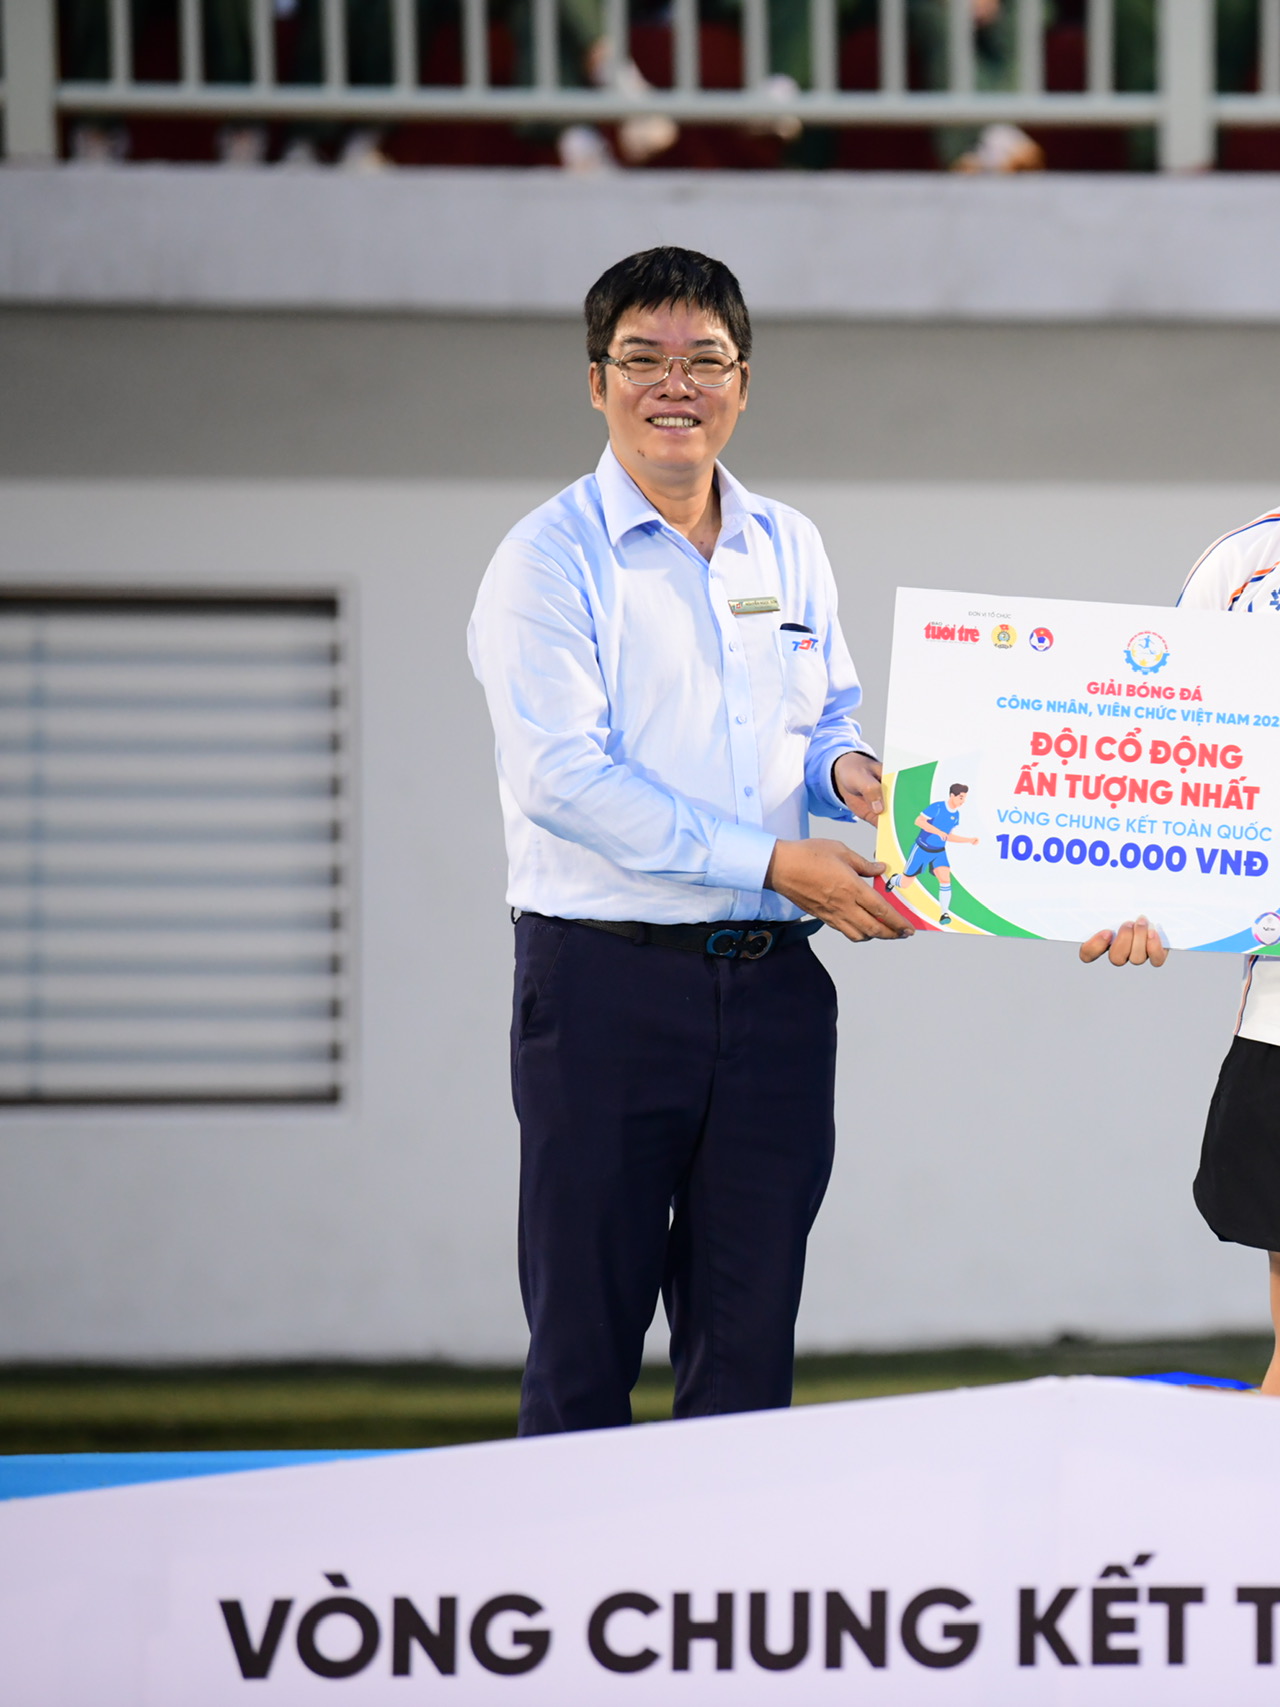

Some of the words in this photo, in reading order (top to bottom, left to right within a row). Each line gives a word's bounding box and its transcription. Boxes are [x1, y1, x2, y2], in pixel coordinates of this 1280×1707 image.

[996, 694, 1042, 711] CÔNG
[1046, 698, 1093, 718] NHÂN,
[1097, 702, 1131, 718] VIÊN
[1134, 704, 1177, 720] CHỨC
[1181, 708, 1213, 726] VIỆT
[1216, 712, 1250, 726] NAM
[1086, 680, 1122, 696] GIẢI
[1126, 682, 1176, 700] BÓNG
[1179, 685, 1203, 702] ĐÁ
[1030, 727, 1088, 766] ĐỘI
[1095, 727, 1142, 763] CỔ
[1149, 736, 1244, 774] ĐỘNG
[1014, 762, 1058, 798] ẤN
[1064, 773, 1174, 810] TƯỢNG
[1180, 776, 1260, 810] NHẤT
[996, 806, 1050, 826] VÒNG
[1055, 813, 1121, 832] CHUNG
[1126, 814, 1158, 834] KẾT
[1162, 819, 1212, 838] TOÀN
[1216, 821, 1272, 842] QUỐC
[996, 833, 1188, 872] 10.000.000
[1195, 847, 1270, 877] VNĐ
[218, 1571, 552, 1680] VÒNG
[587, 1587, 982, 1674] CHUNG
[1016, 1553, 1204, 1668] KẾT
